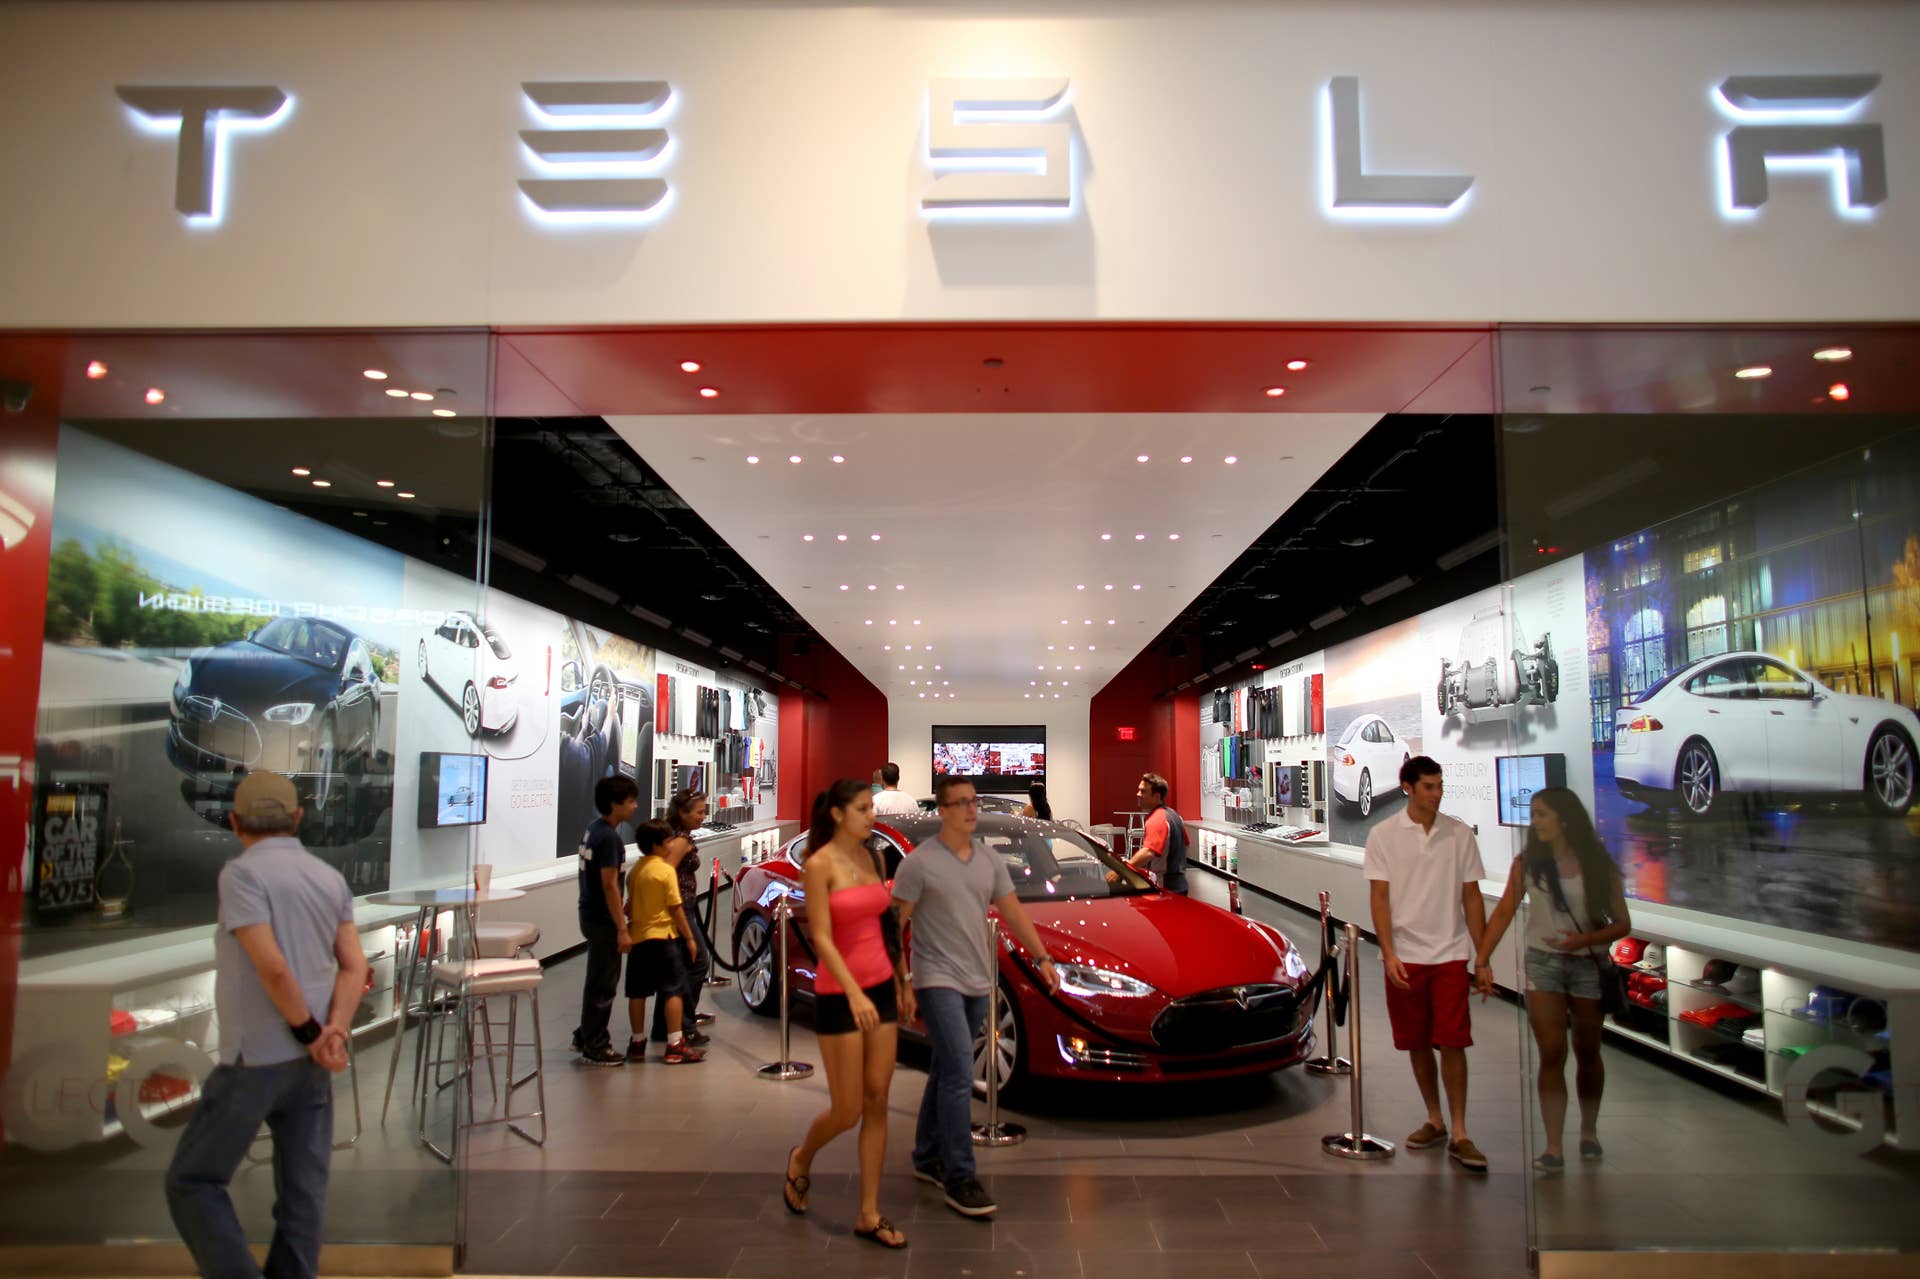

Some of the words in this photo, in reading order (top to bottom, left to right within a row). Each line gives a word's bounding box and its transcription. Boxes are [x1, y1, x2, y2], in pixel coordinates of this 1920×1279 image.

[115, 73, 1888, 222] TESLA
[1443, 784, 1494, 801] ERFORMANCE
[44, 815, 99, 844] CAR
[42, 843, 65, 863] OF
[67, 841, 97, 861] THE
[53, 861, 95, 880] YEAR
[40, 880, 93, 909] 2013
